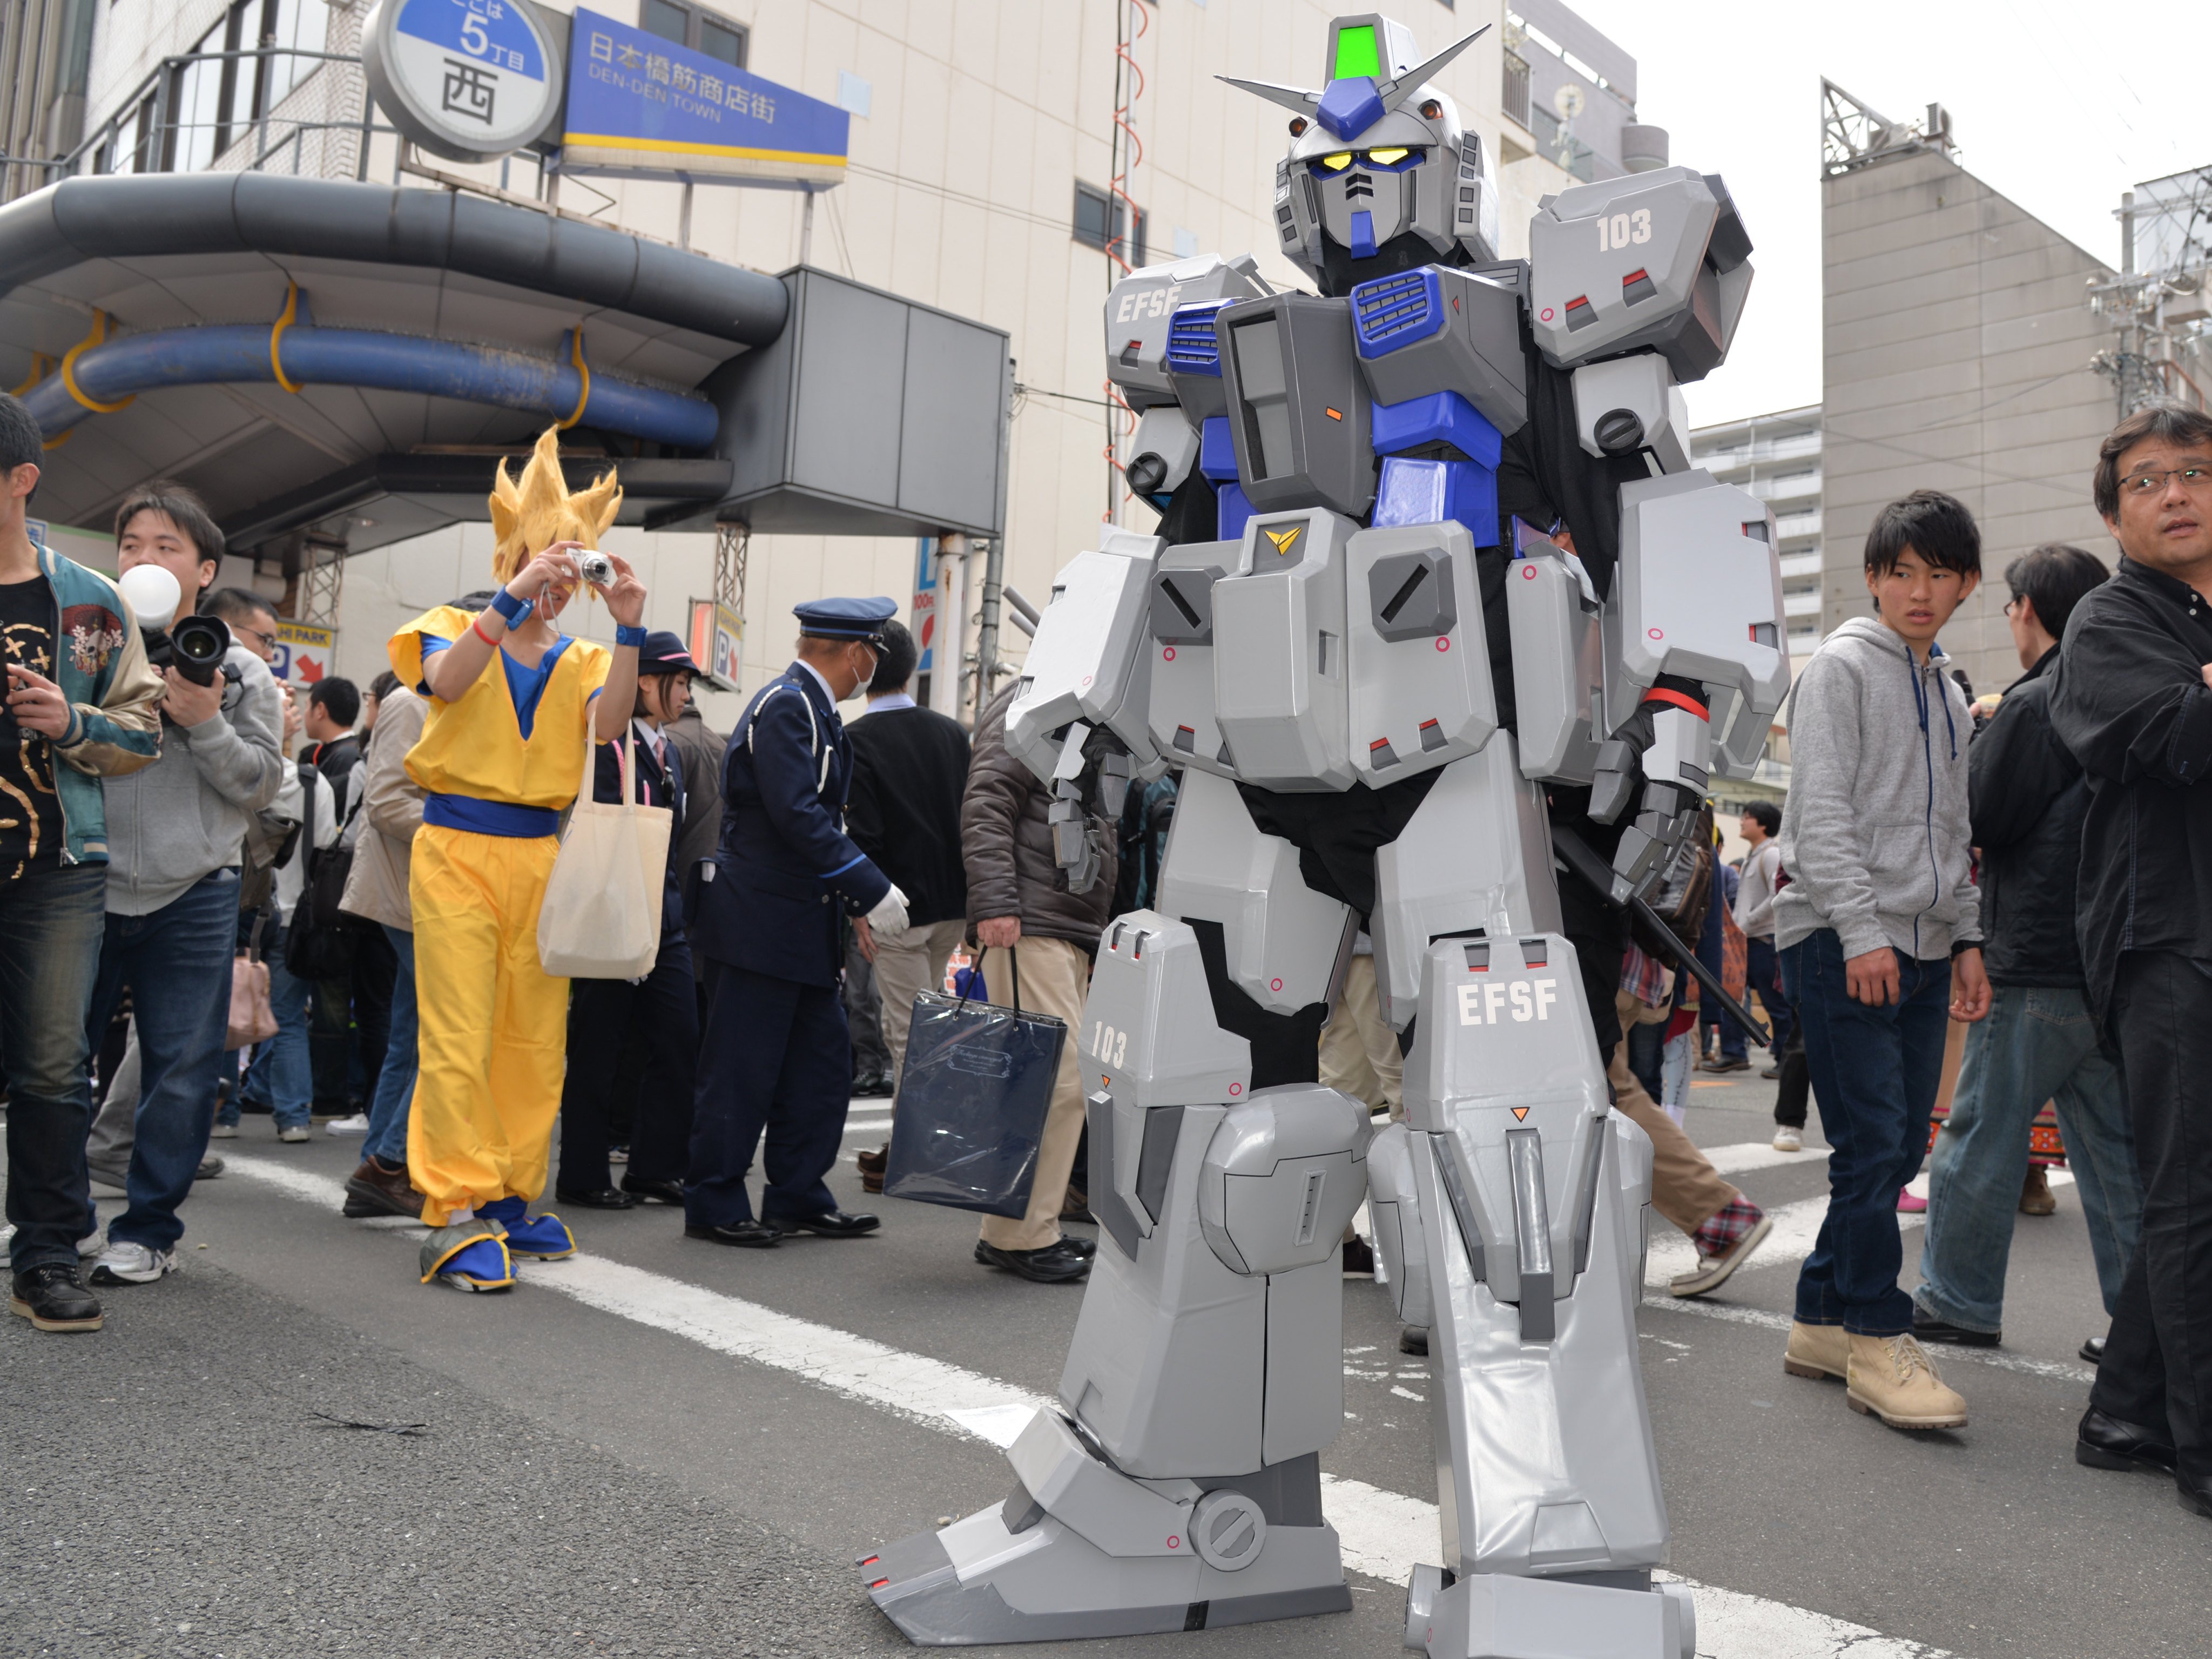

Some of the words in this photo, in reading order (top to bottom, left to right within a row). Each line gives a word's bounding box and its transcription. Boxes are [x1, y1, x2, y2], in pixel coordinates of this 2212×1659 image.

[460, 12, 524, 71] 5丁目
[442, 57, 498, 126] 西
[589, 63, 667, 104] DEN-DEN
[672, 93, 721, 124] TOWN
[590, 31, 776, 124] 日本橋筋商店街
[1597, 208, 1651, 252] 103
[1116, 285, 1182, 323] EFSF
[295, 629, 327, 645] PARK
[1457, 979, 1556, 1026] EFSF
[1092, 1021, 1127, 1069] 103
